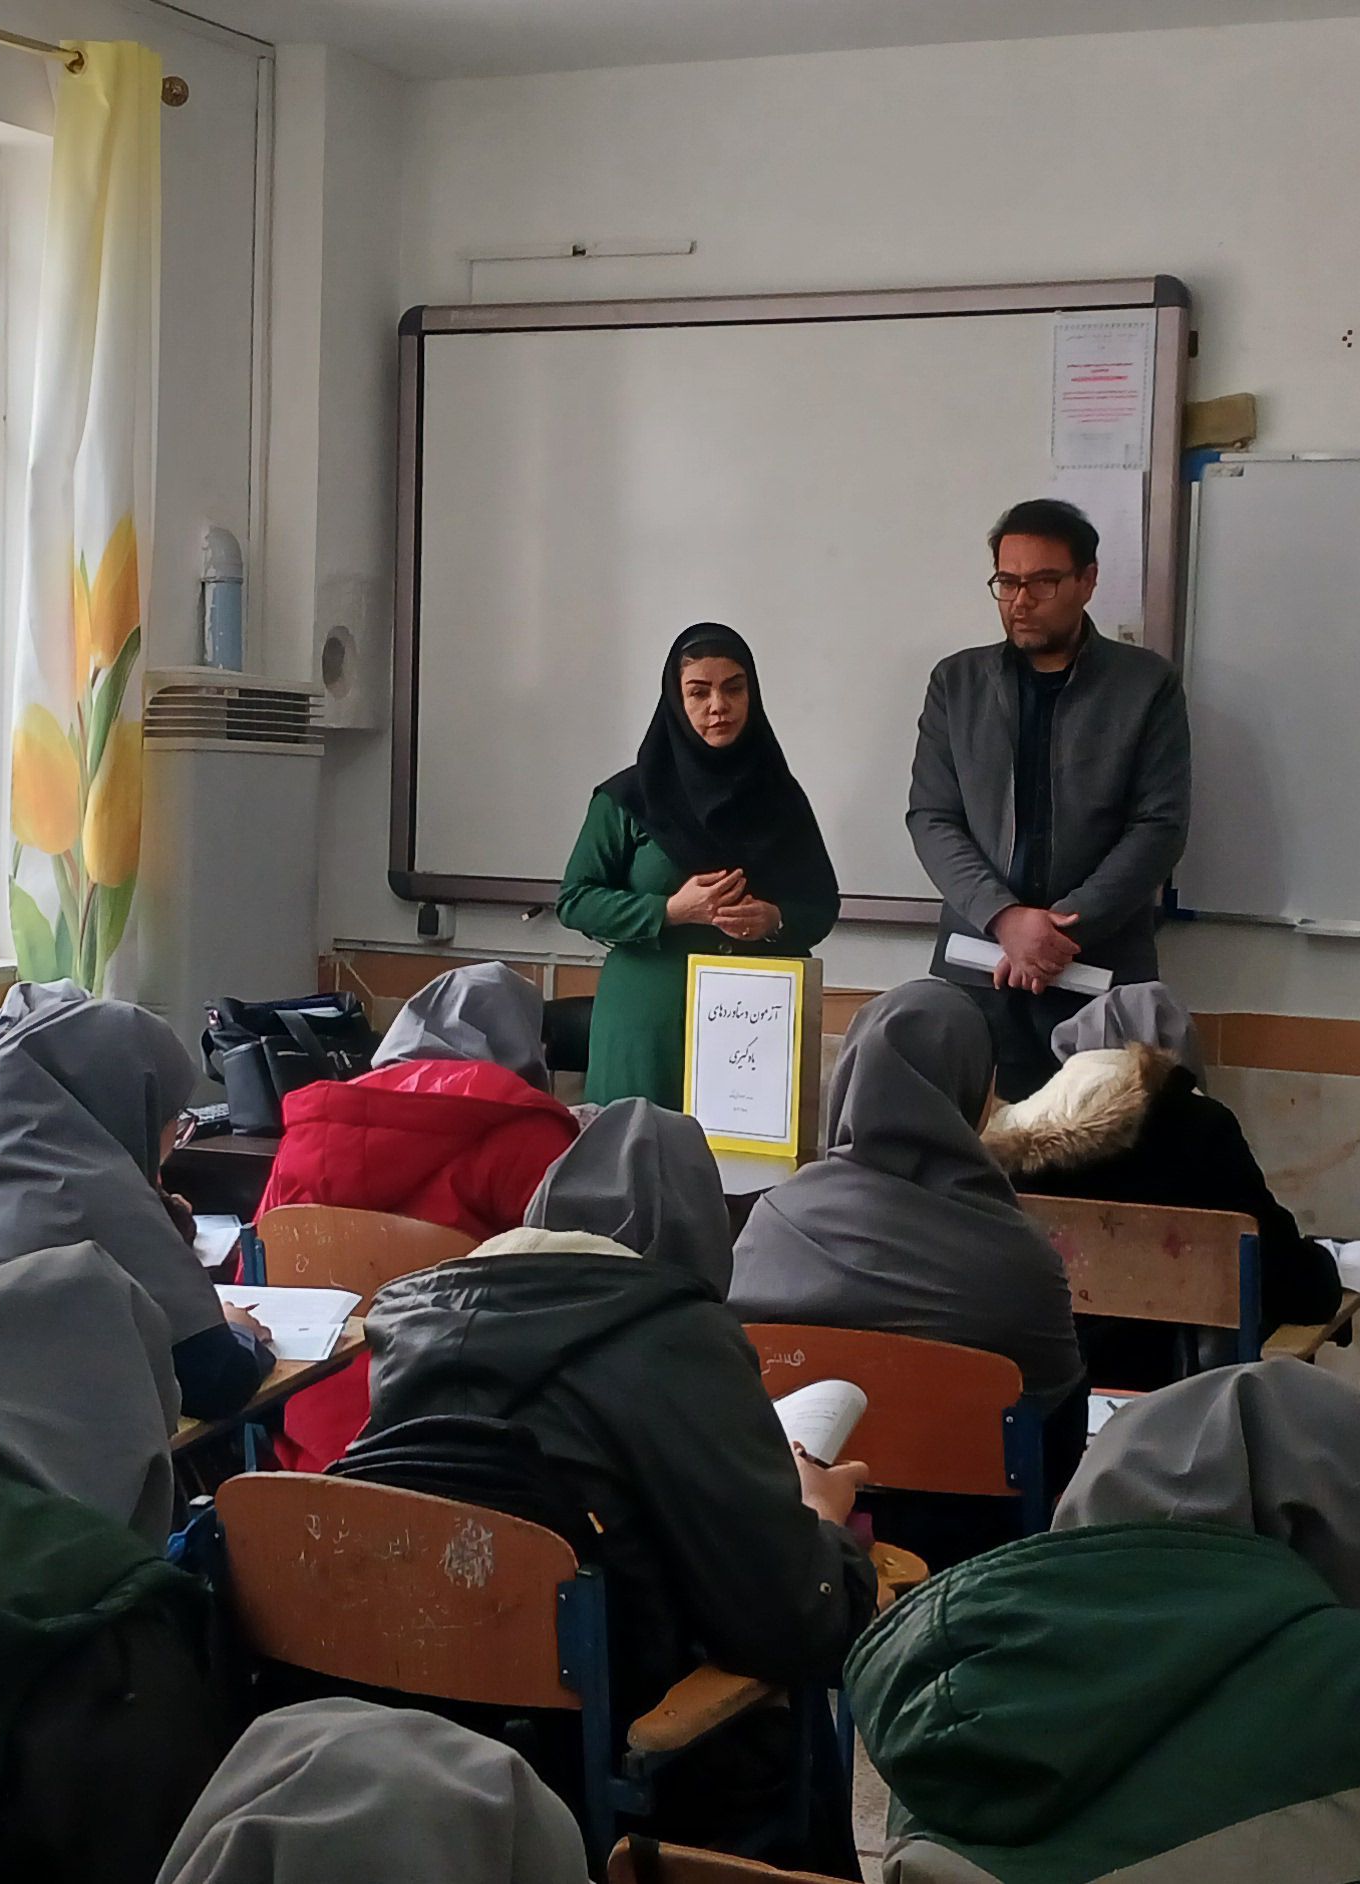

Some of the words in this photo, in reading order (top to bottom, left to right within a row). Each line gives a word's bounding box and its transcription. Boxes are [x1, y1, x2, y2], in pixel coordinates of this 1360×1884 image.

[708, 1001, 749, 1022] دستاوردهای
[749, 1006, 782, 1024] آزمون
[729, 1036, 758, 1071] یادگیری
